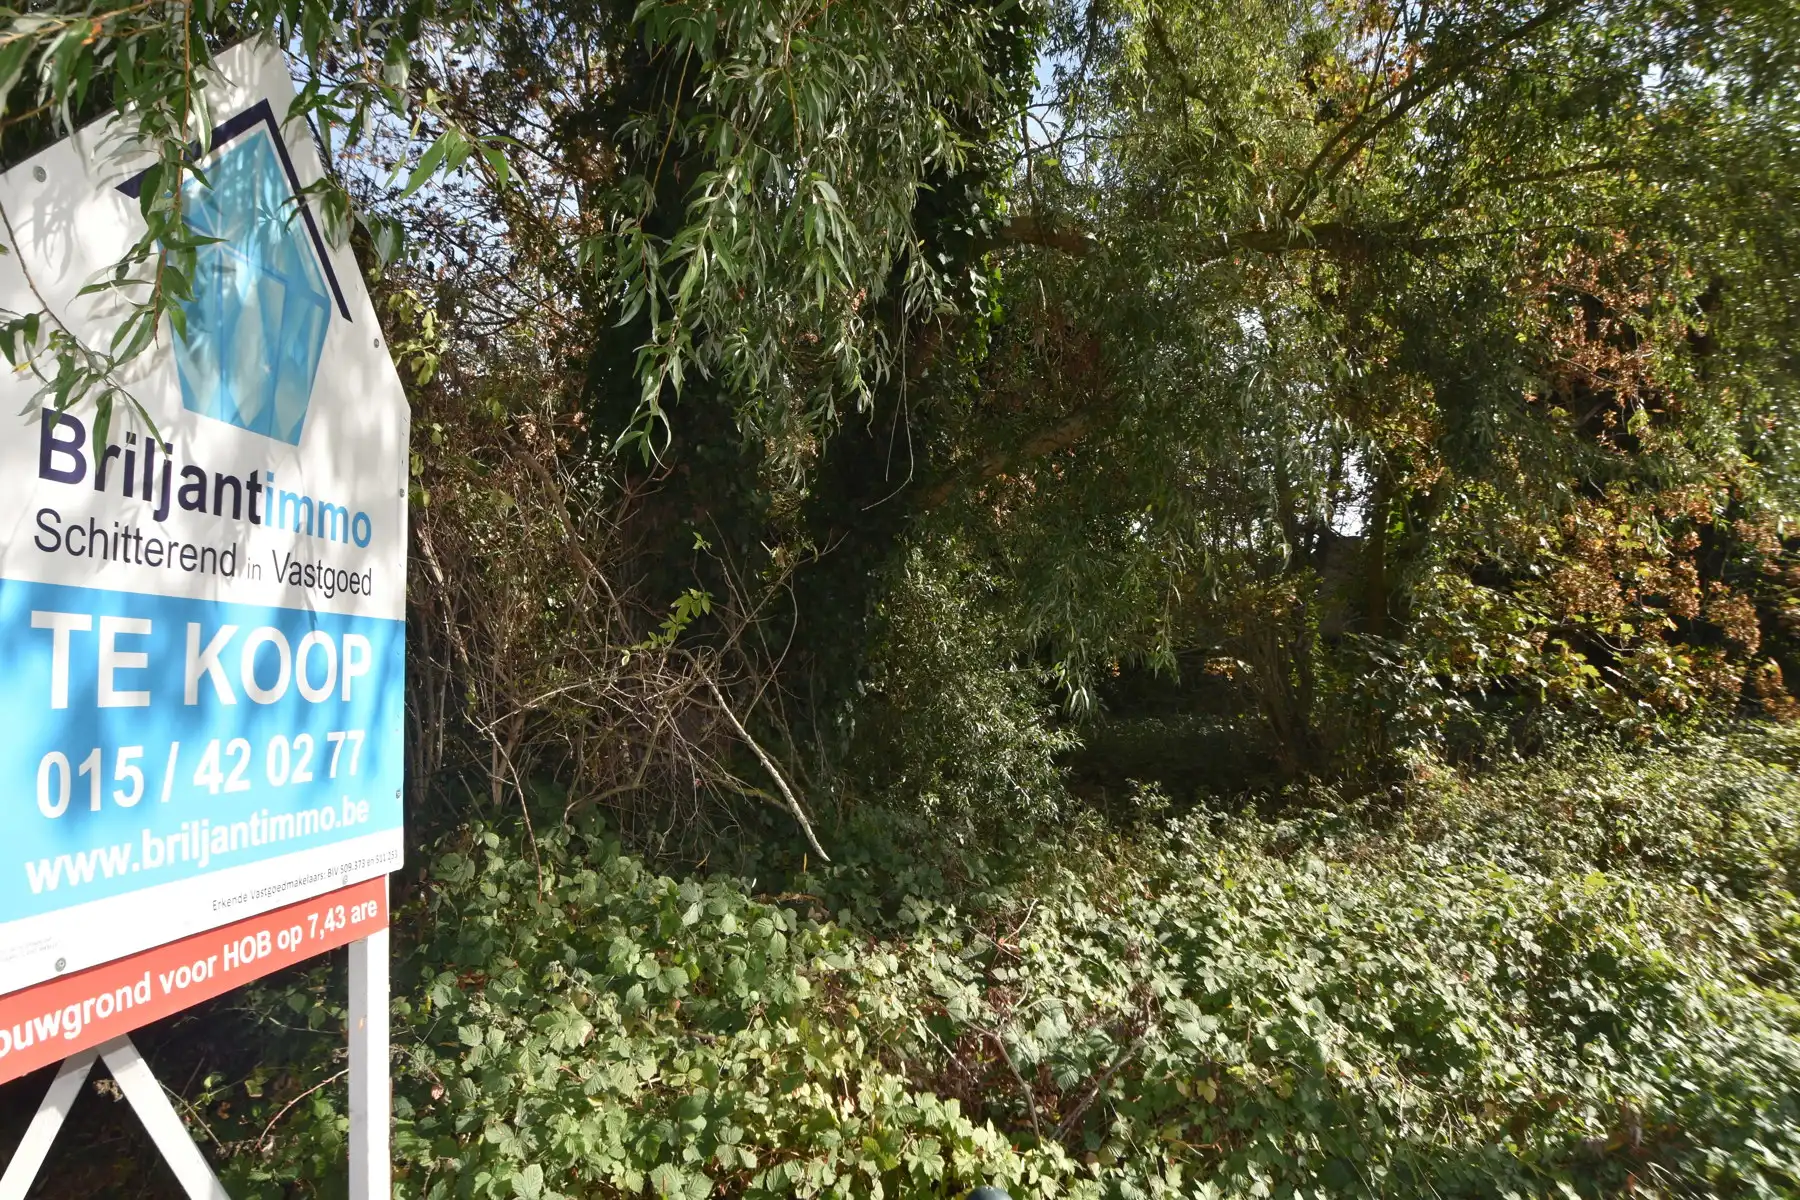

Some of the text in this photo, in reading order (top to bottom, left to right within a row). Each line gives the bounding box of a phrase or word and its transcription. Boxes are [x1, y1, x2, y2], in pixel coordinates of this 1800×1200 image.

[38, 407, 372, 549] Briljantimmo
[34, 508, 372, 599] Schitterend in Vastgoed
[31, 610, 372, 709] TE KOOP
[36, 730, 366, 819] 015 / 42 02 77
[25, 796, 370, 895] www.briljantimmo.be
[212, 891, 248, 912] Erkende
[250, 872, 327, 900] Vastgoedmakelaars:
[327, 863, 340, 879] BIV
[366, 857, 376, 868] en
[159, 954, 219, 994] voor
[223, 931, 272, 972] HOB
[277, 924, 302, 950] op
[307, 905, 346, 939] 7,43
[350, 899, 378, 922] are
